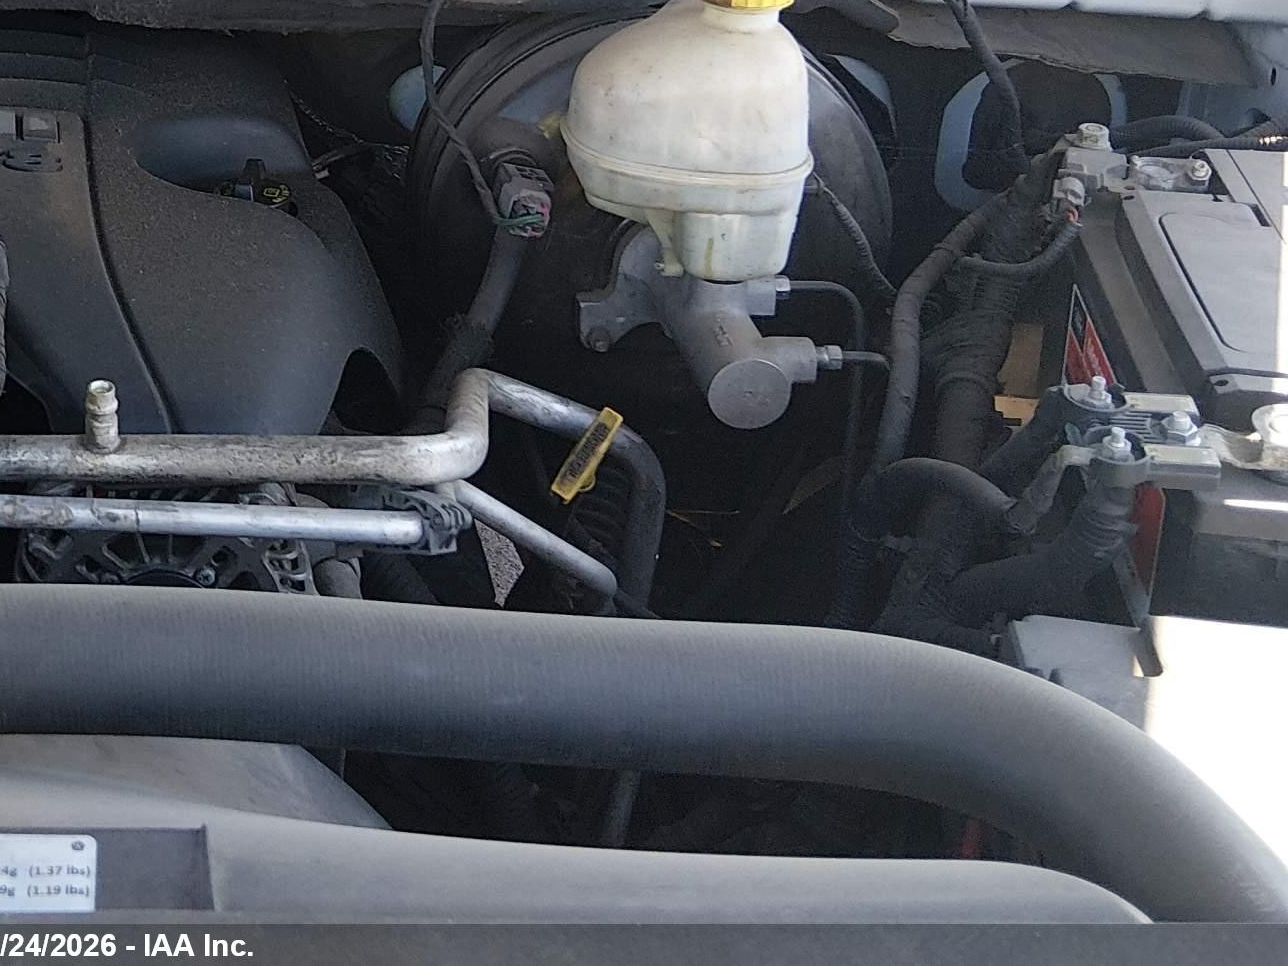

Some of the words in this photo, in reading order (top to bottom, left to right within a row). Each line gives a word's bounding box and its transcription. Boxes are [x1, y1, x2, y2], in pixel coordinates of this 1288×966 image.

[28, 865, 63, 877] (1.37
[66, 865, 91, 877] lbs)
[27, 884, 61, 897] (1.19
[65, 884, 90, 896] lbs)
